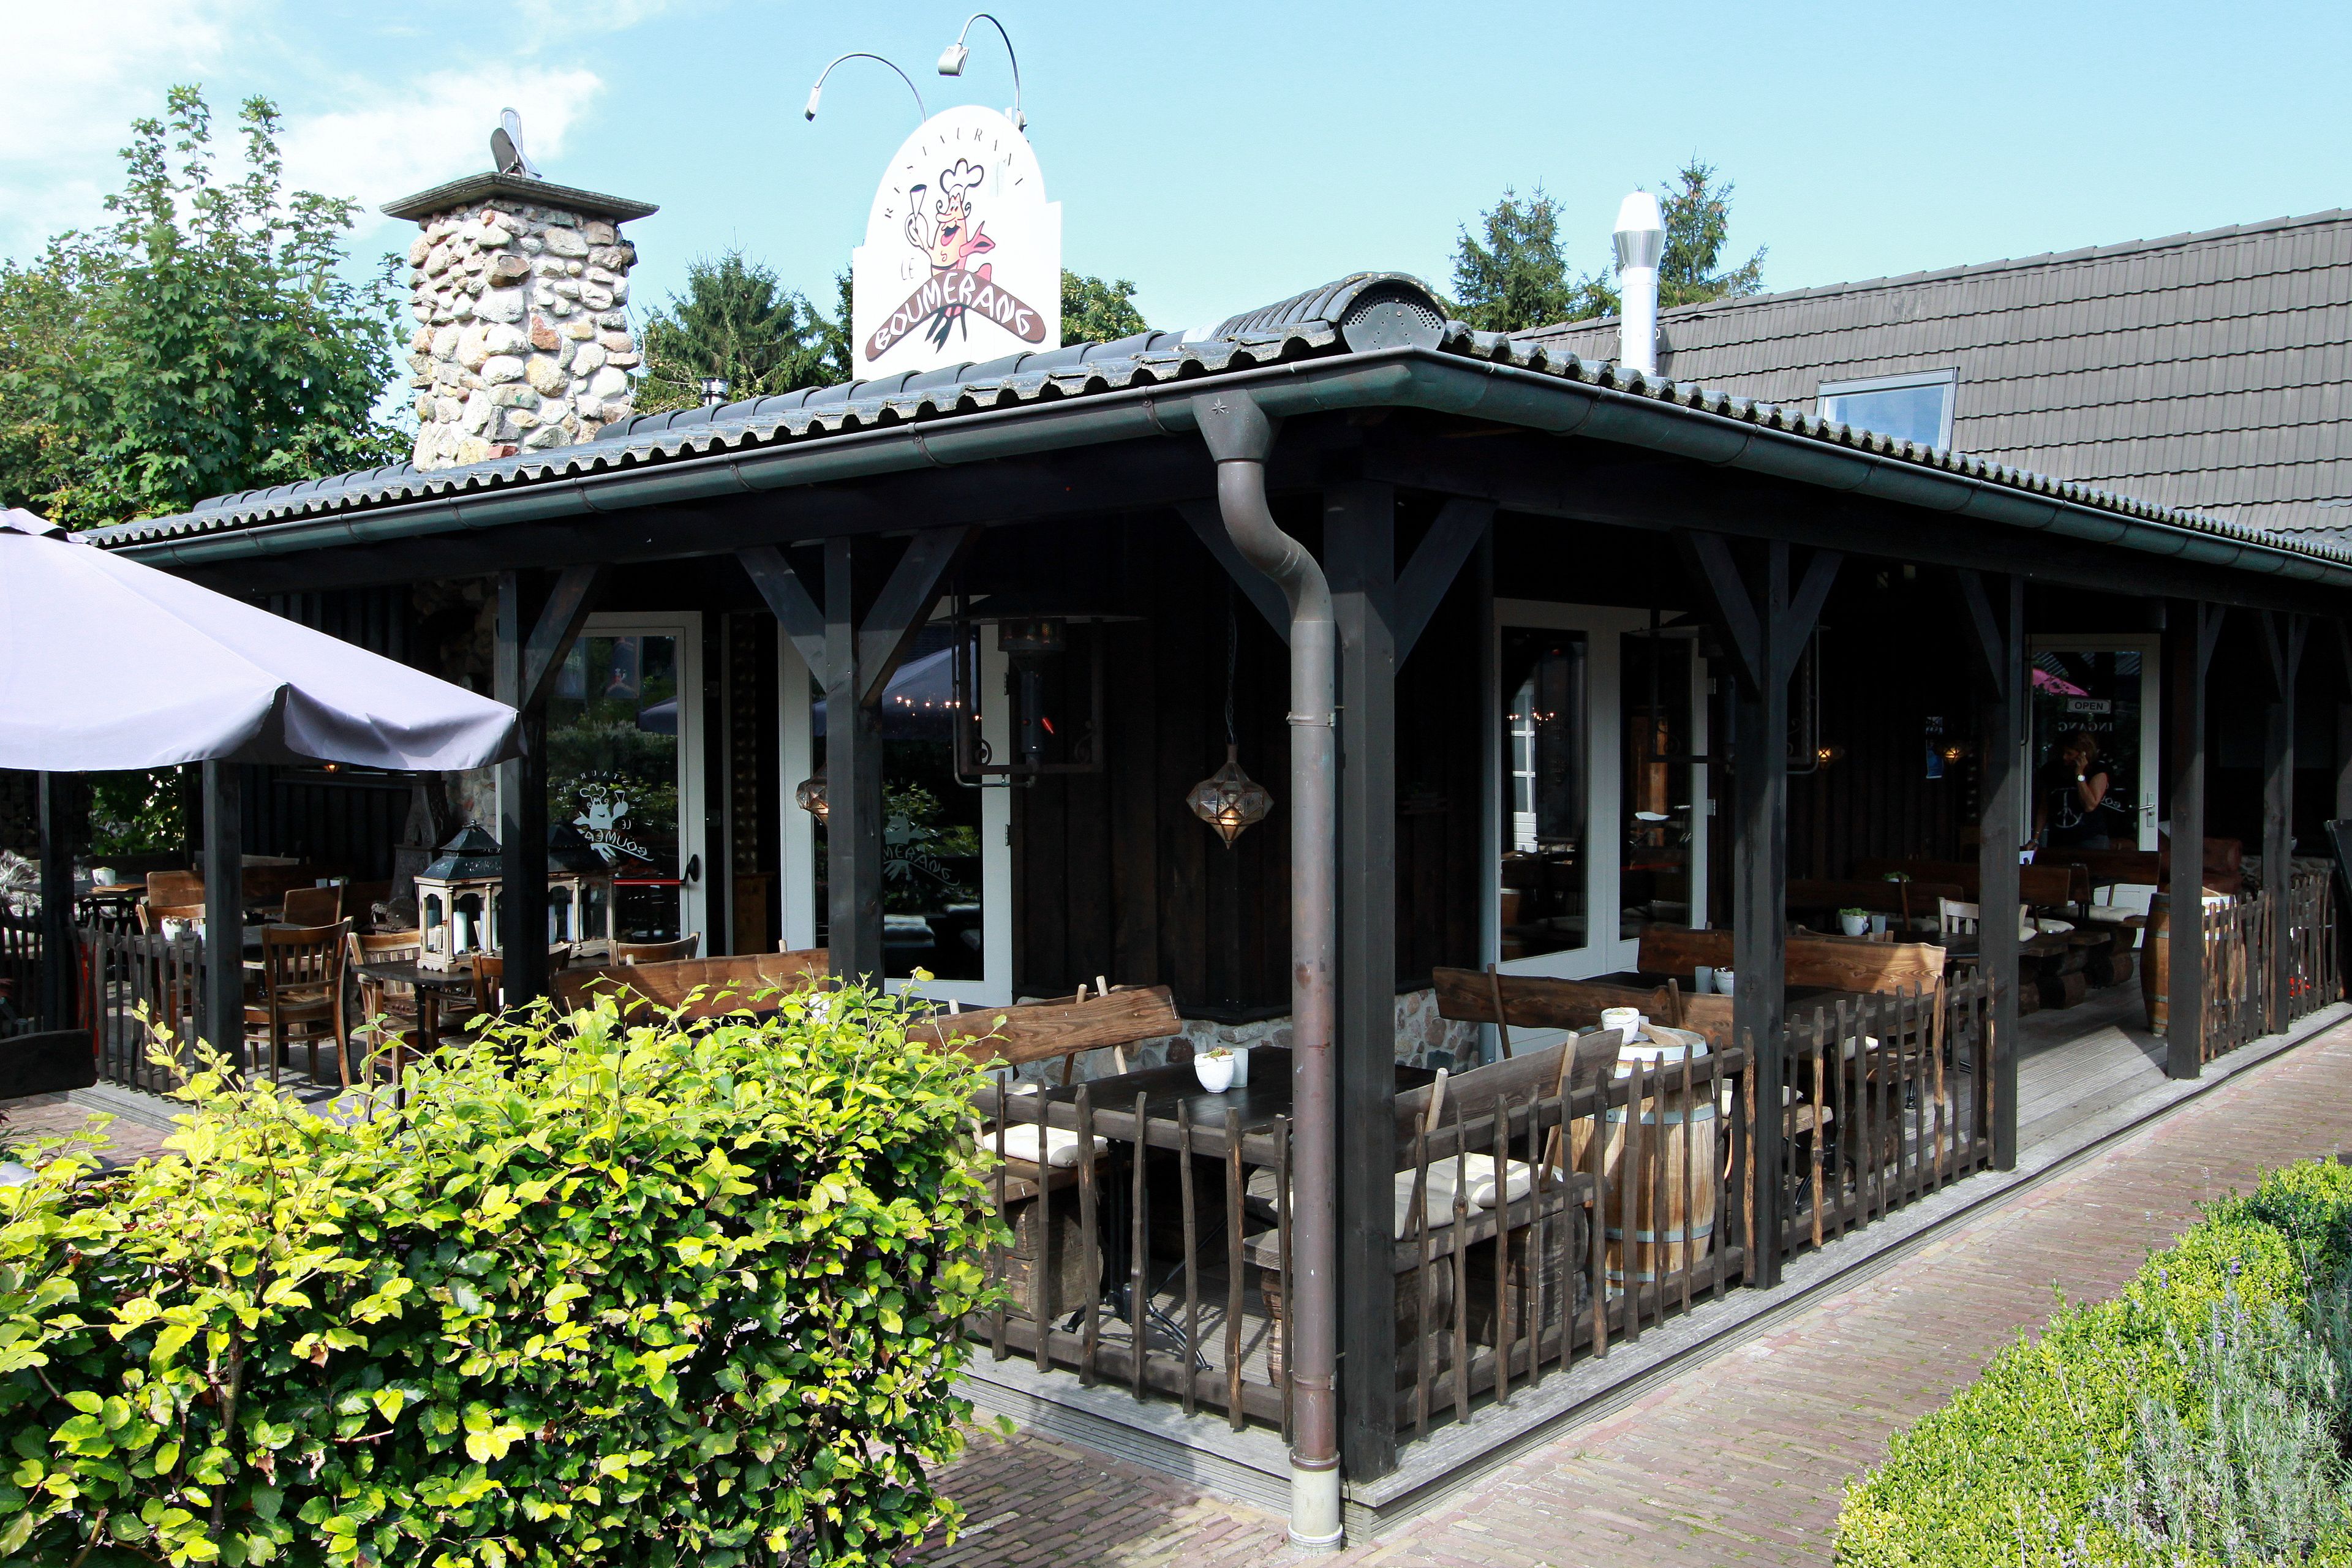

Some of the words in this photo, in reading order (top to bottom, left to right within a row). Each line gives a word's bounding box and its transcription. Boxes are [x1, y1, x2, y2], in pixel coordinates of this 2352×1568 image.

[901, 257, 915, 281] LE
[874, 271, 1035, 351] BOUMERANG
[2075, 701, 2103, 710] OPEN
[883, 843, 953, 880] MERANG
